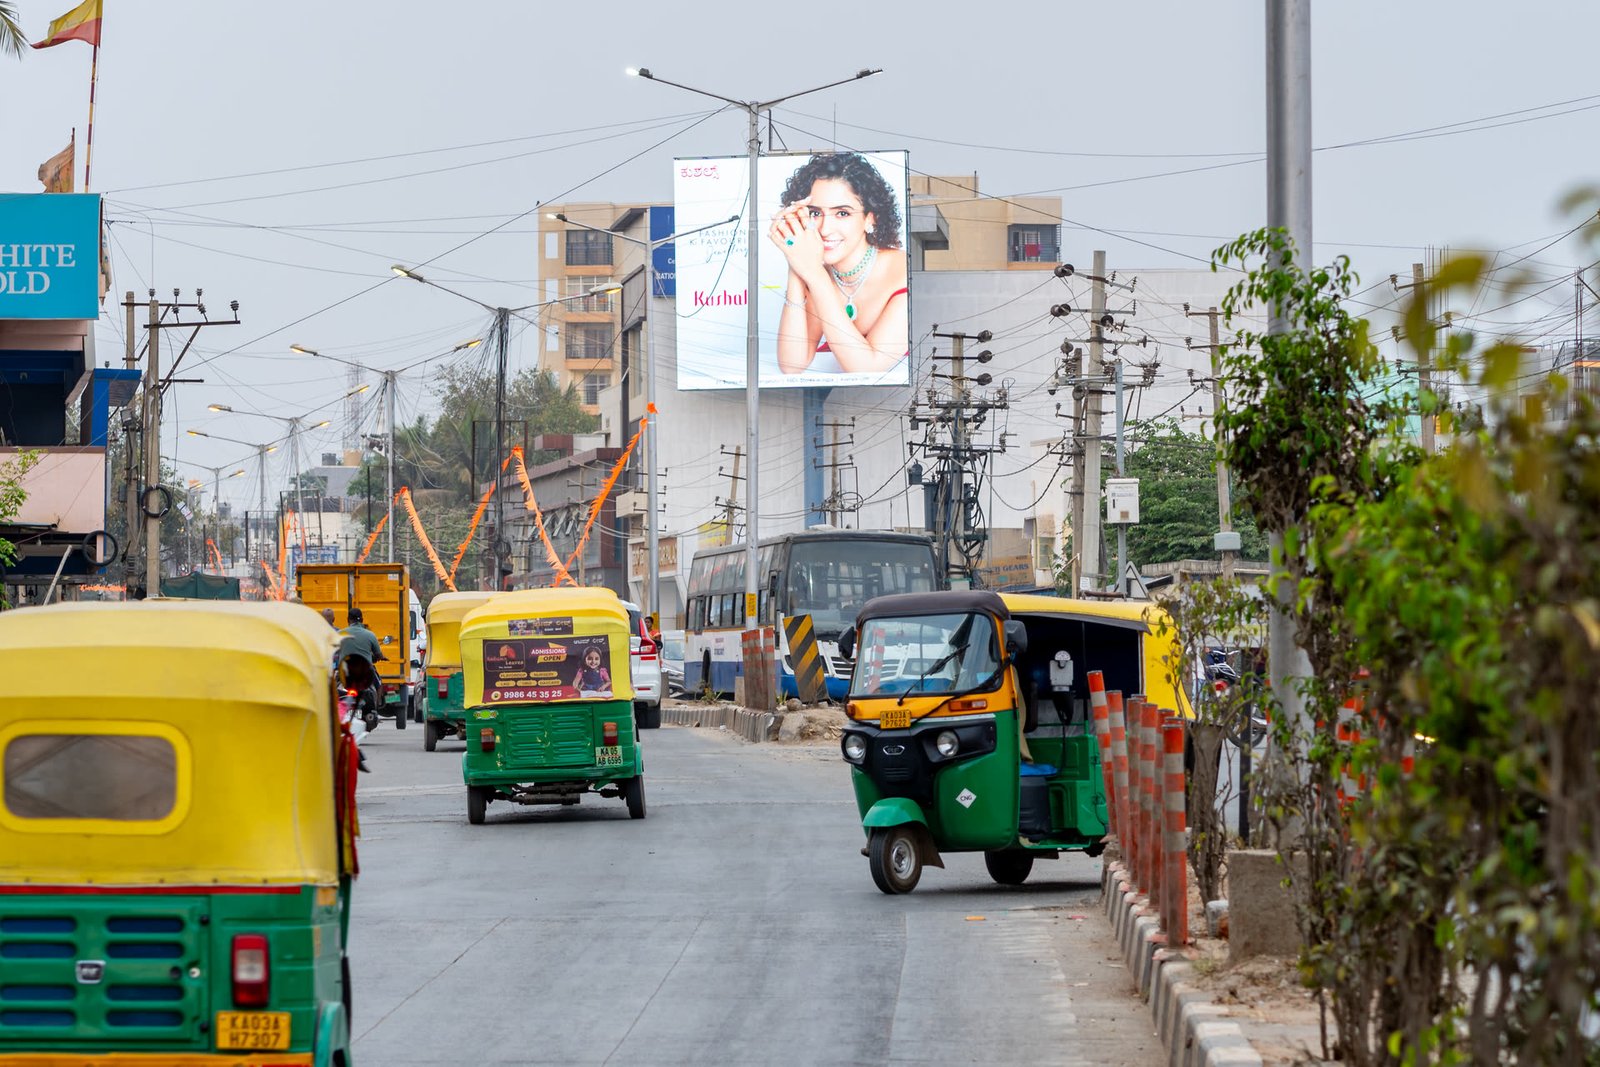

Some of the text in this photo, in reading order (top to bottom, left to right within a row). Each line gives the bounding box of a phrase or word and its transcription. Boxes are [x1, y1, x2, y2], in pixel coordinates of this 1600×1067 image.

[699, 229, 746, 237] FASHION
[526, 690, 537, 698] 45
[539, 690, 550, 698] 35
[600, 747, 609, 755] KA
[230, 1016, 280, 1030] KA03A
